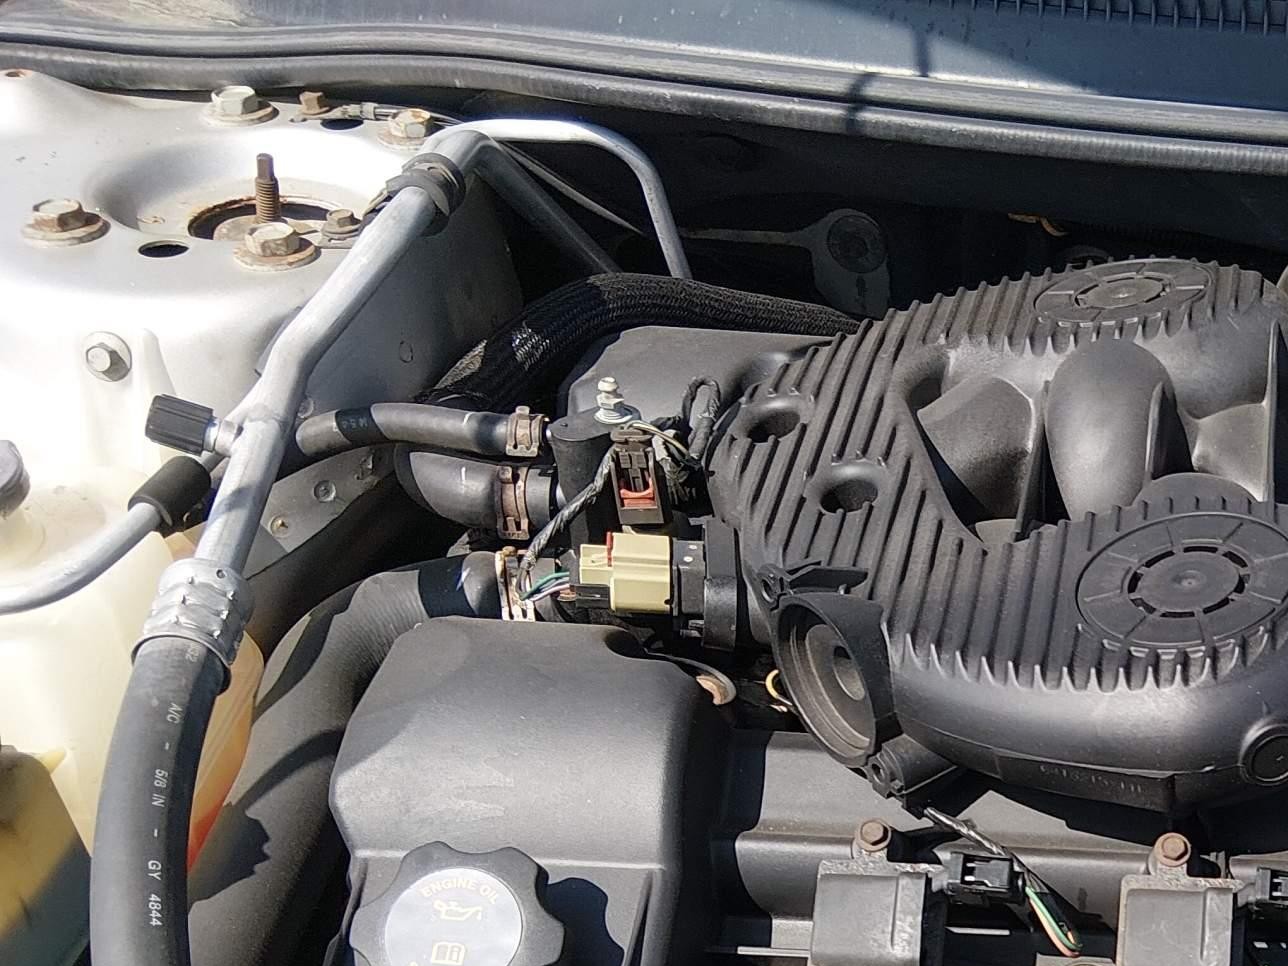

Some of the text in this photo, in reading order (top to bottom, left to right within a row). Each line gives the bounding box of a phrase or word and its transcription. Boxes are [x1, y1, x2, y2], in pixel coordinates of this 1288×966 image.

[166, 702, 183, 724] A/C
[155, 768, 169, 787] 5/8
[152, 794, 167, 807] IN
[148, 860, 162, 880] GY
[421, 878, 499, 904] ENGINE OIL
[148, 893, 162, 927] 4844
